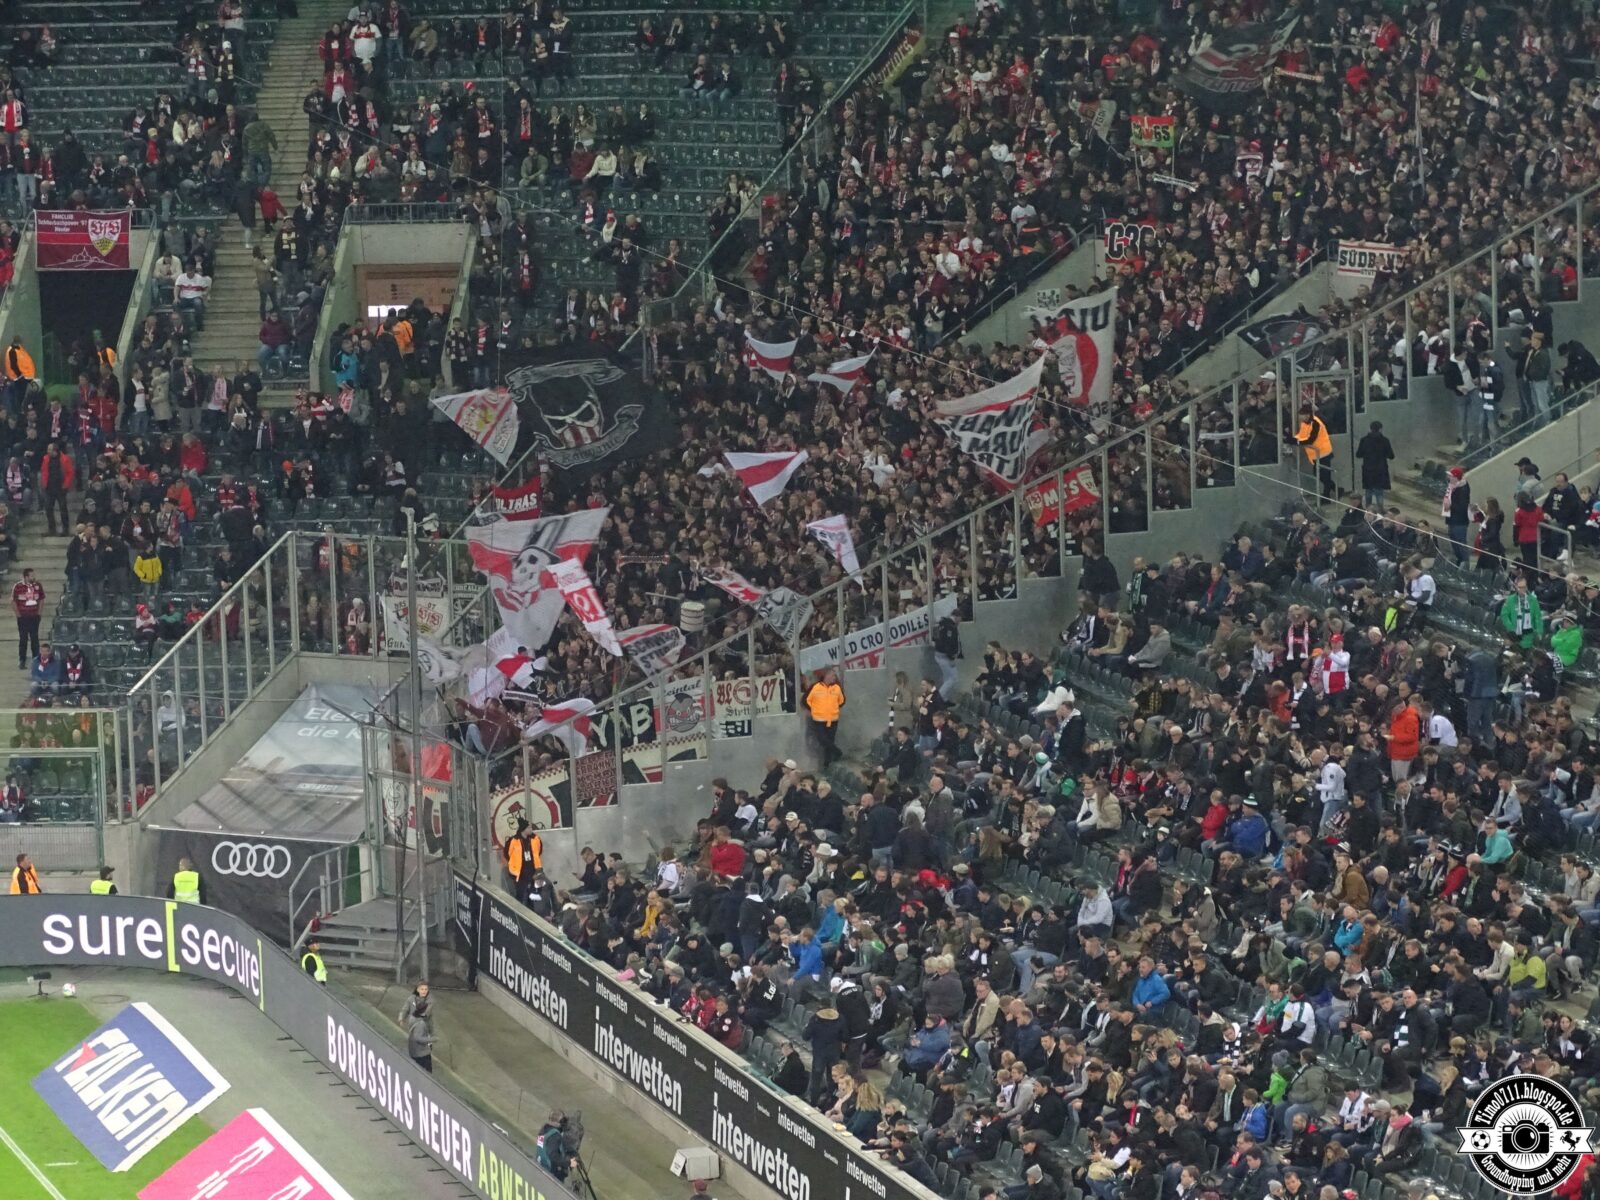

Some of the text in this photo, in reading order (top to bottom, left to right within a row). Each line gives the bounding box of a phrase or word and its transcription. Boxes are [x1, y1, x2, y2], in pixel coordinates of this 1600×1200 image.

[827, 641, 857, 662] WLD
[860, 613, 929, 648] CROODILES
[726, 705, 769, 716] Stuttart
[761, 678, 777, 702] 07
[297, 727, 338, 738] die
[490, 901, 519, 936] interwetten
[541, 938, 572, 974] interwetten
[489, 929, 568, 1030] interwetten
[595, 976, 628, 1014] interwetten
[653, 1017, 687, 1057] interwetten
[594, 1005, 683, 1115] interwetten
[714, 1060, 749, 1102] interwetten
[54, 1028, 188, 1151] FALKEN
[327, 1015, 414, 1131] BORUSSIAS
[418, 1090, 472, 1182] NEUER
[712, 1091, 811, 1200] interwetten
[777, 1106, 816, 1149] interwetten
[846, 1154, 886, 1199] interwetten
